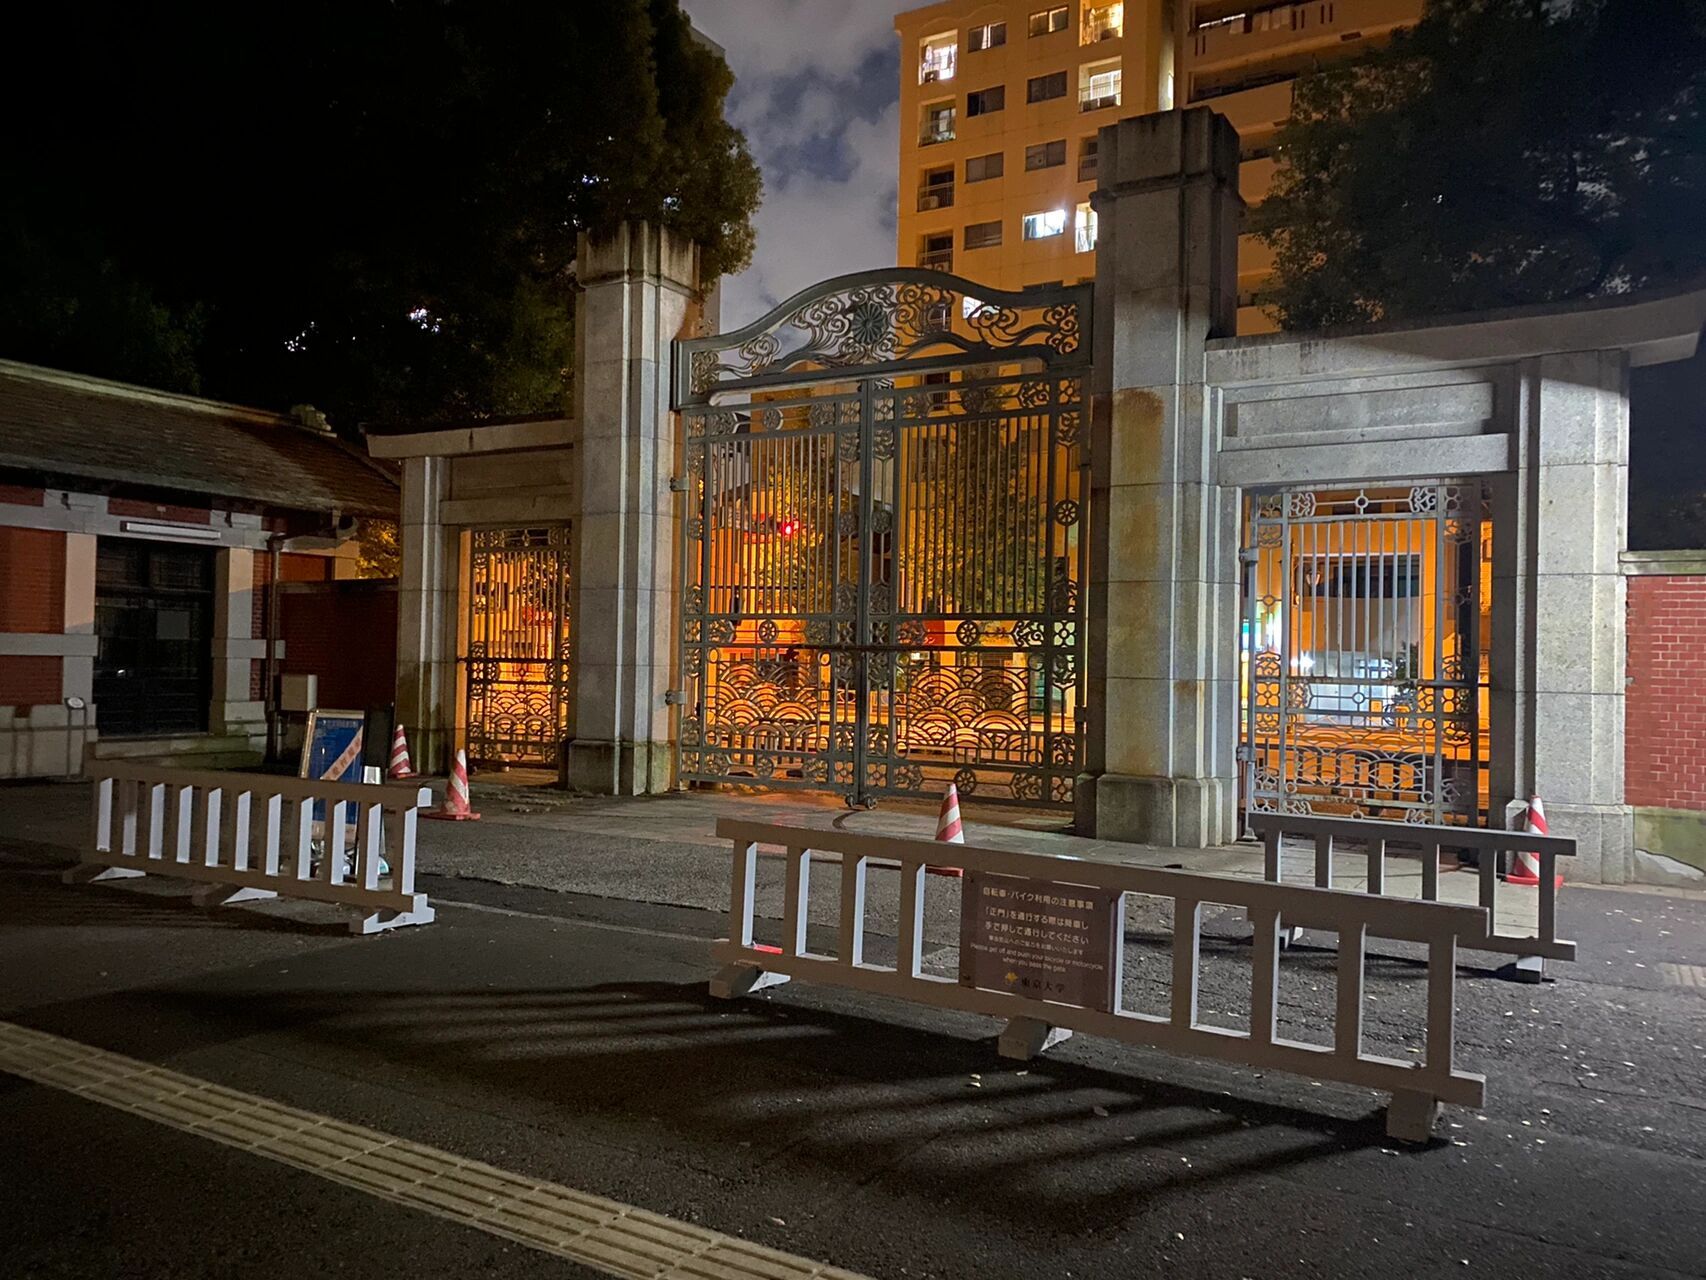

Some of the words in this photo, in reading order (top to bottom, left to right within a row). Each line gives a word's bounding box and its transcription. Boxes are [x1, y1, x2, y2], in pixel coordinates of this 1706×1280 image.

[985, 921, 1089, 945] 手で押して通行してください
[970, 942, 988, 952] Please
[989, 945, 998, 953] get
[1007, 948, 1017, 956] and
[1018, 951, 1031, 959] push
[1032, 953, 1044, 961] your
[1045, 955, 1064, 965] bicycle
[1072, 960, 1104, 971] motorcycle
[1003, 957, 1018, 965] when
[1019, 960, 1028, 968] you
[1029, 961, 1042, 970] pass
[1053, 965, 1066, 973] gate
[1021, 977, 1065, 993] 東京大学
